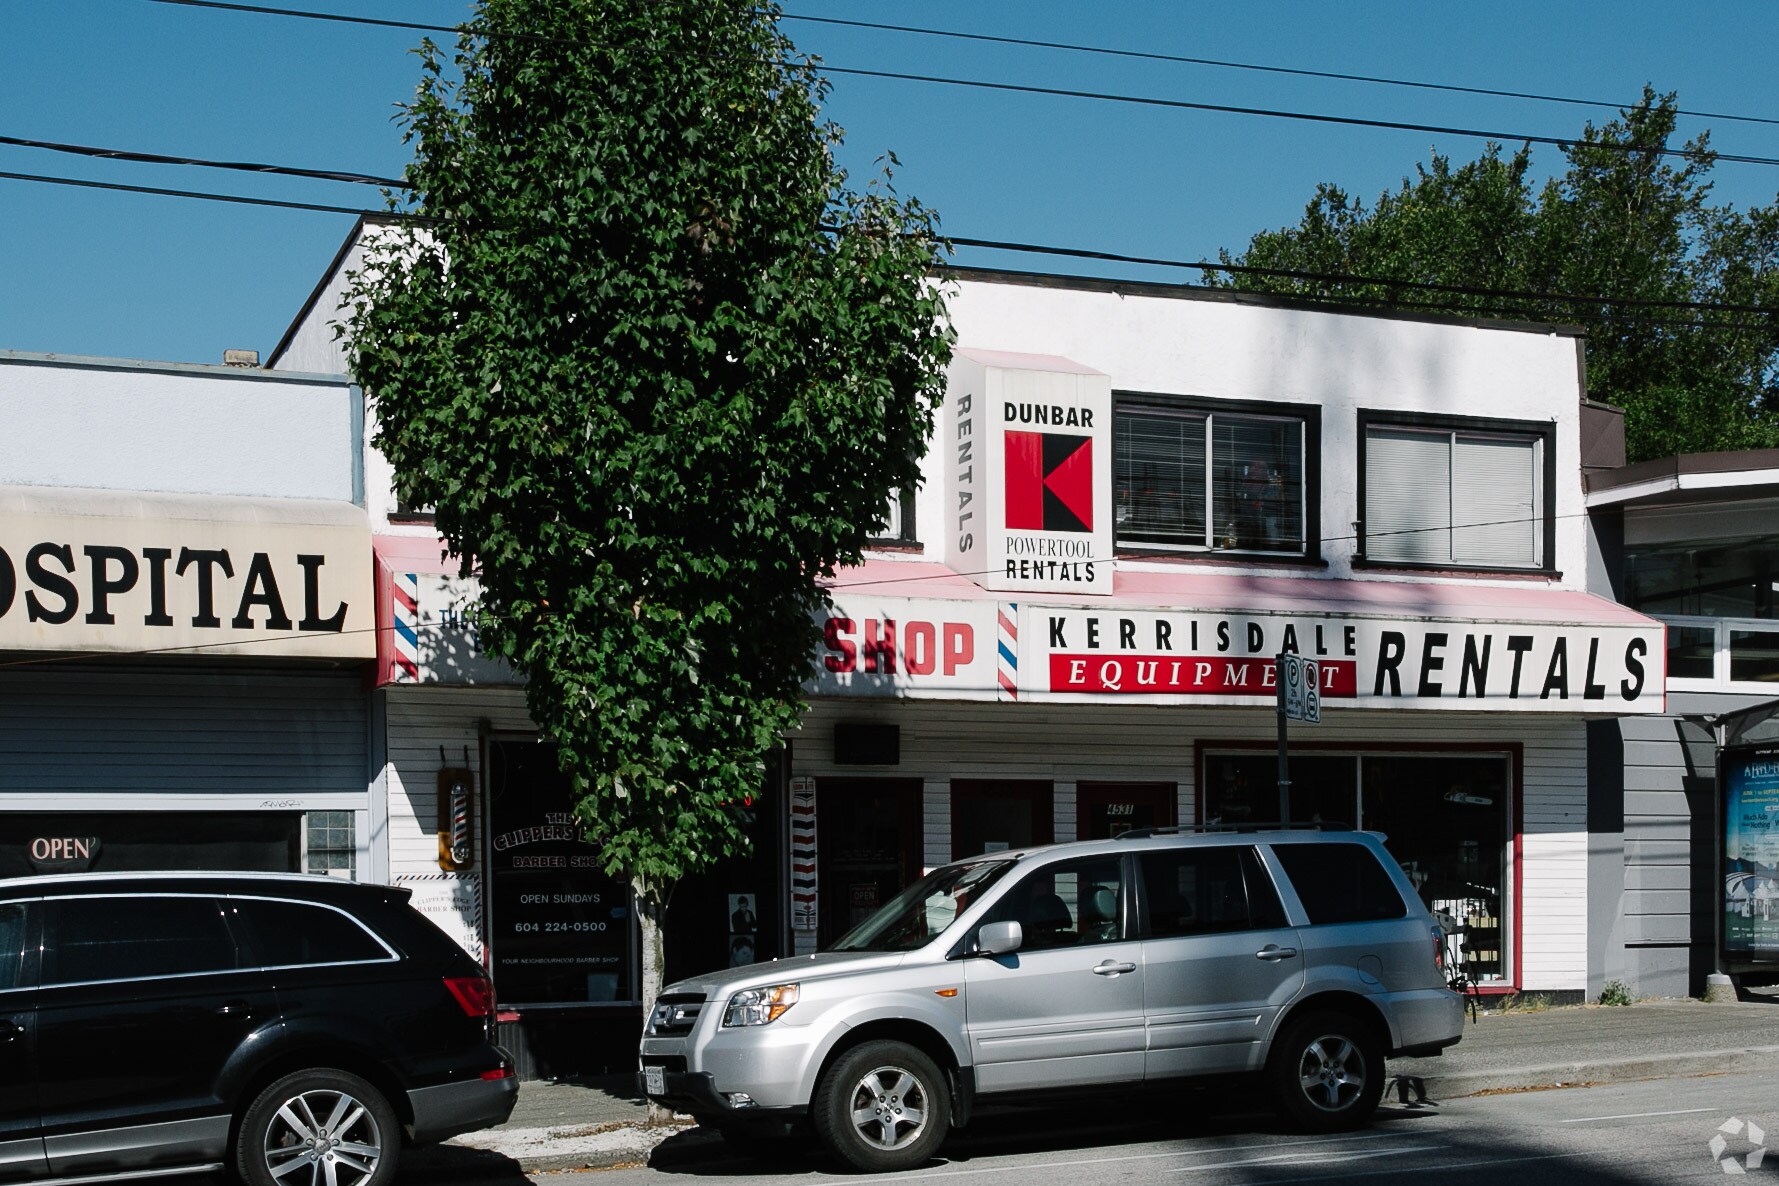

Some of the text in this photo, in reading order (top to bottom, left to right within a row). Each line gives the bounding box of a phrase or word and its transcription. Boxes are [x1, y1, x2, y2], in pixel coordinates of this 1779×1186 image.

[1004, 402, 1094, 429] DUNBAR
[957, 393, 974, 554] RENTALS
[1006, 536, 1094, 559] POWERTOOL
[1006, 559, 1095, 583] RENTALS
[0, 541, 349, 634] SPITAL
[824, 617, 974, 676] SHOP
[1049, 616, 1357, 656] KERRISDALE
[1069, 660, 1341, 691] EQUIPMET
[1373, 631, 1647, 702] RENTALS
[545, 812, 572, 824] THE
[31, 837, 90, 860] OPEN
[513, 856, 604, 868] BARBER SHO
[452, 896, 470, 904] EDGE
[520, 893, 600, 904] OPEN SUNDAYS
[853, 891, 875, 900] OPEN
[417, 905, 448, 913] BARBER
[515, 922, 607, 932] 604 224-0500
[576, 956, 600, 964] BARBER
